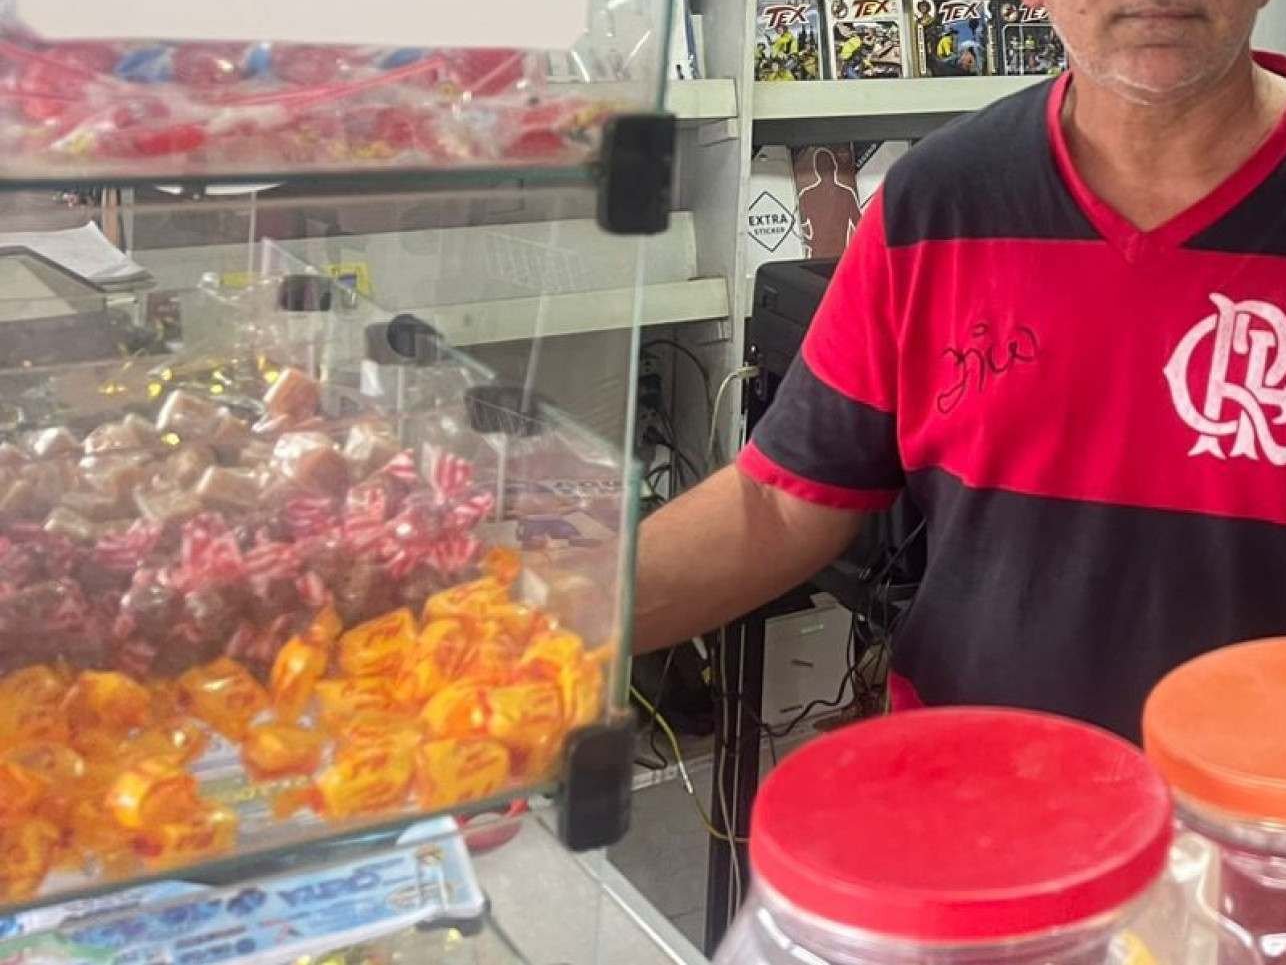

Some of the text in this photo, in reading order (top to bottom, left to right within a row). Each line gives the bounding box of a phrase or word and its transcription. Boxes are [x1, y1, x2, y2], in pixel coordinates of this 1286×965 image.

[763, 3, 810, 28] TEX
[940, 1, 982, 23] TEX
[748, 213, 789, 227] EXTRA
